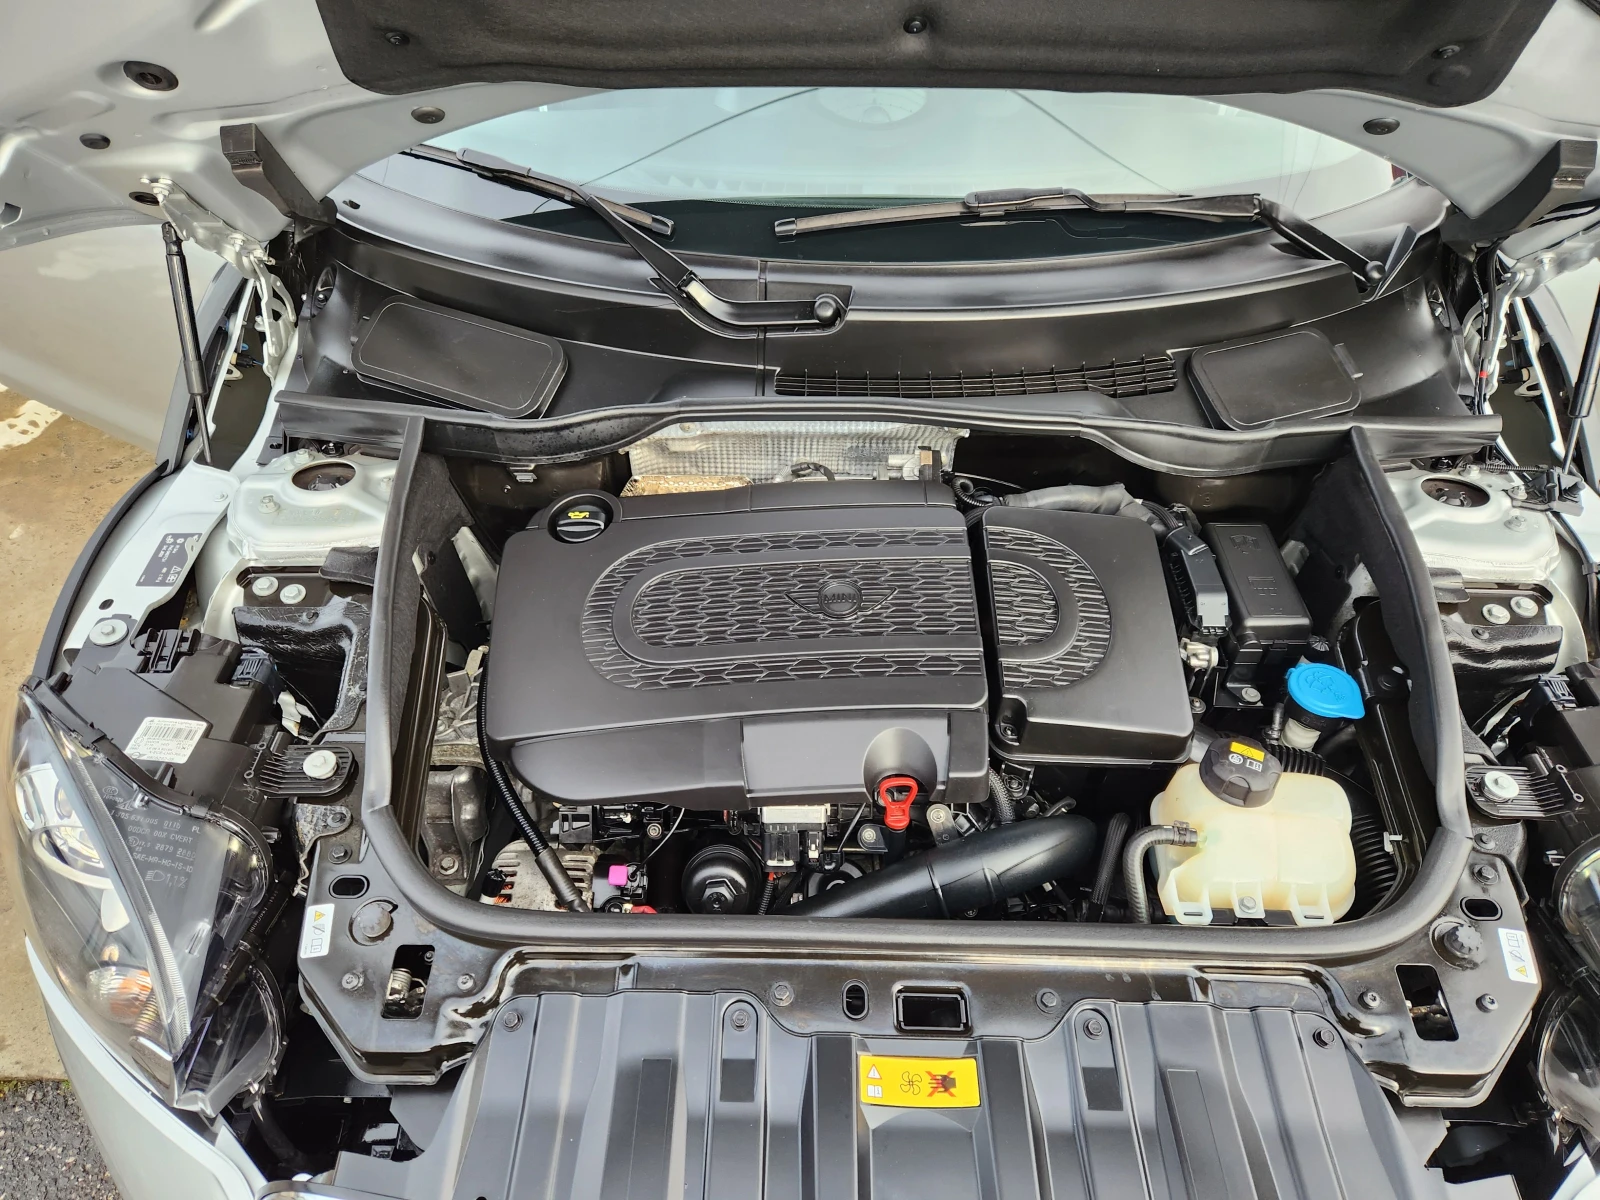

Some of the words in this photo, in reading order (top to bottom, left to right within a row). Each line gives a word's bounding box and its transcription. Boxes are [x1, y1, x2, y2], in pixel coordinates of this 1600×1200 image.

[823, 592, 857, 603] MINI
[191, 825, 201, 834] PL
[169, 833, 193, 844] CVERT
[155, 843, 174, 853] 2879
